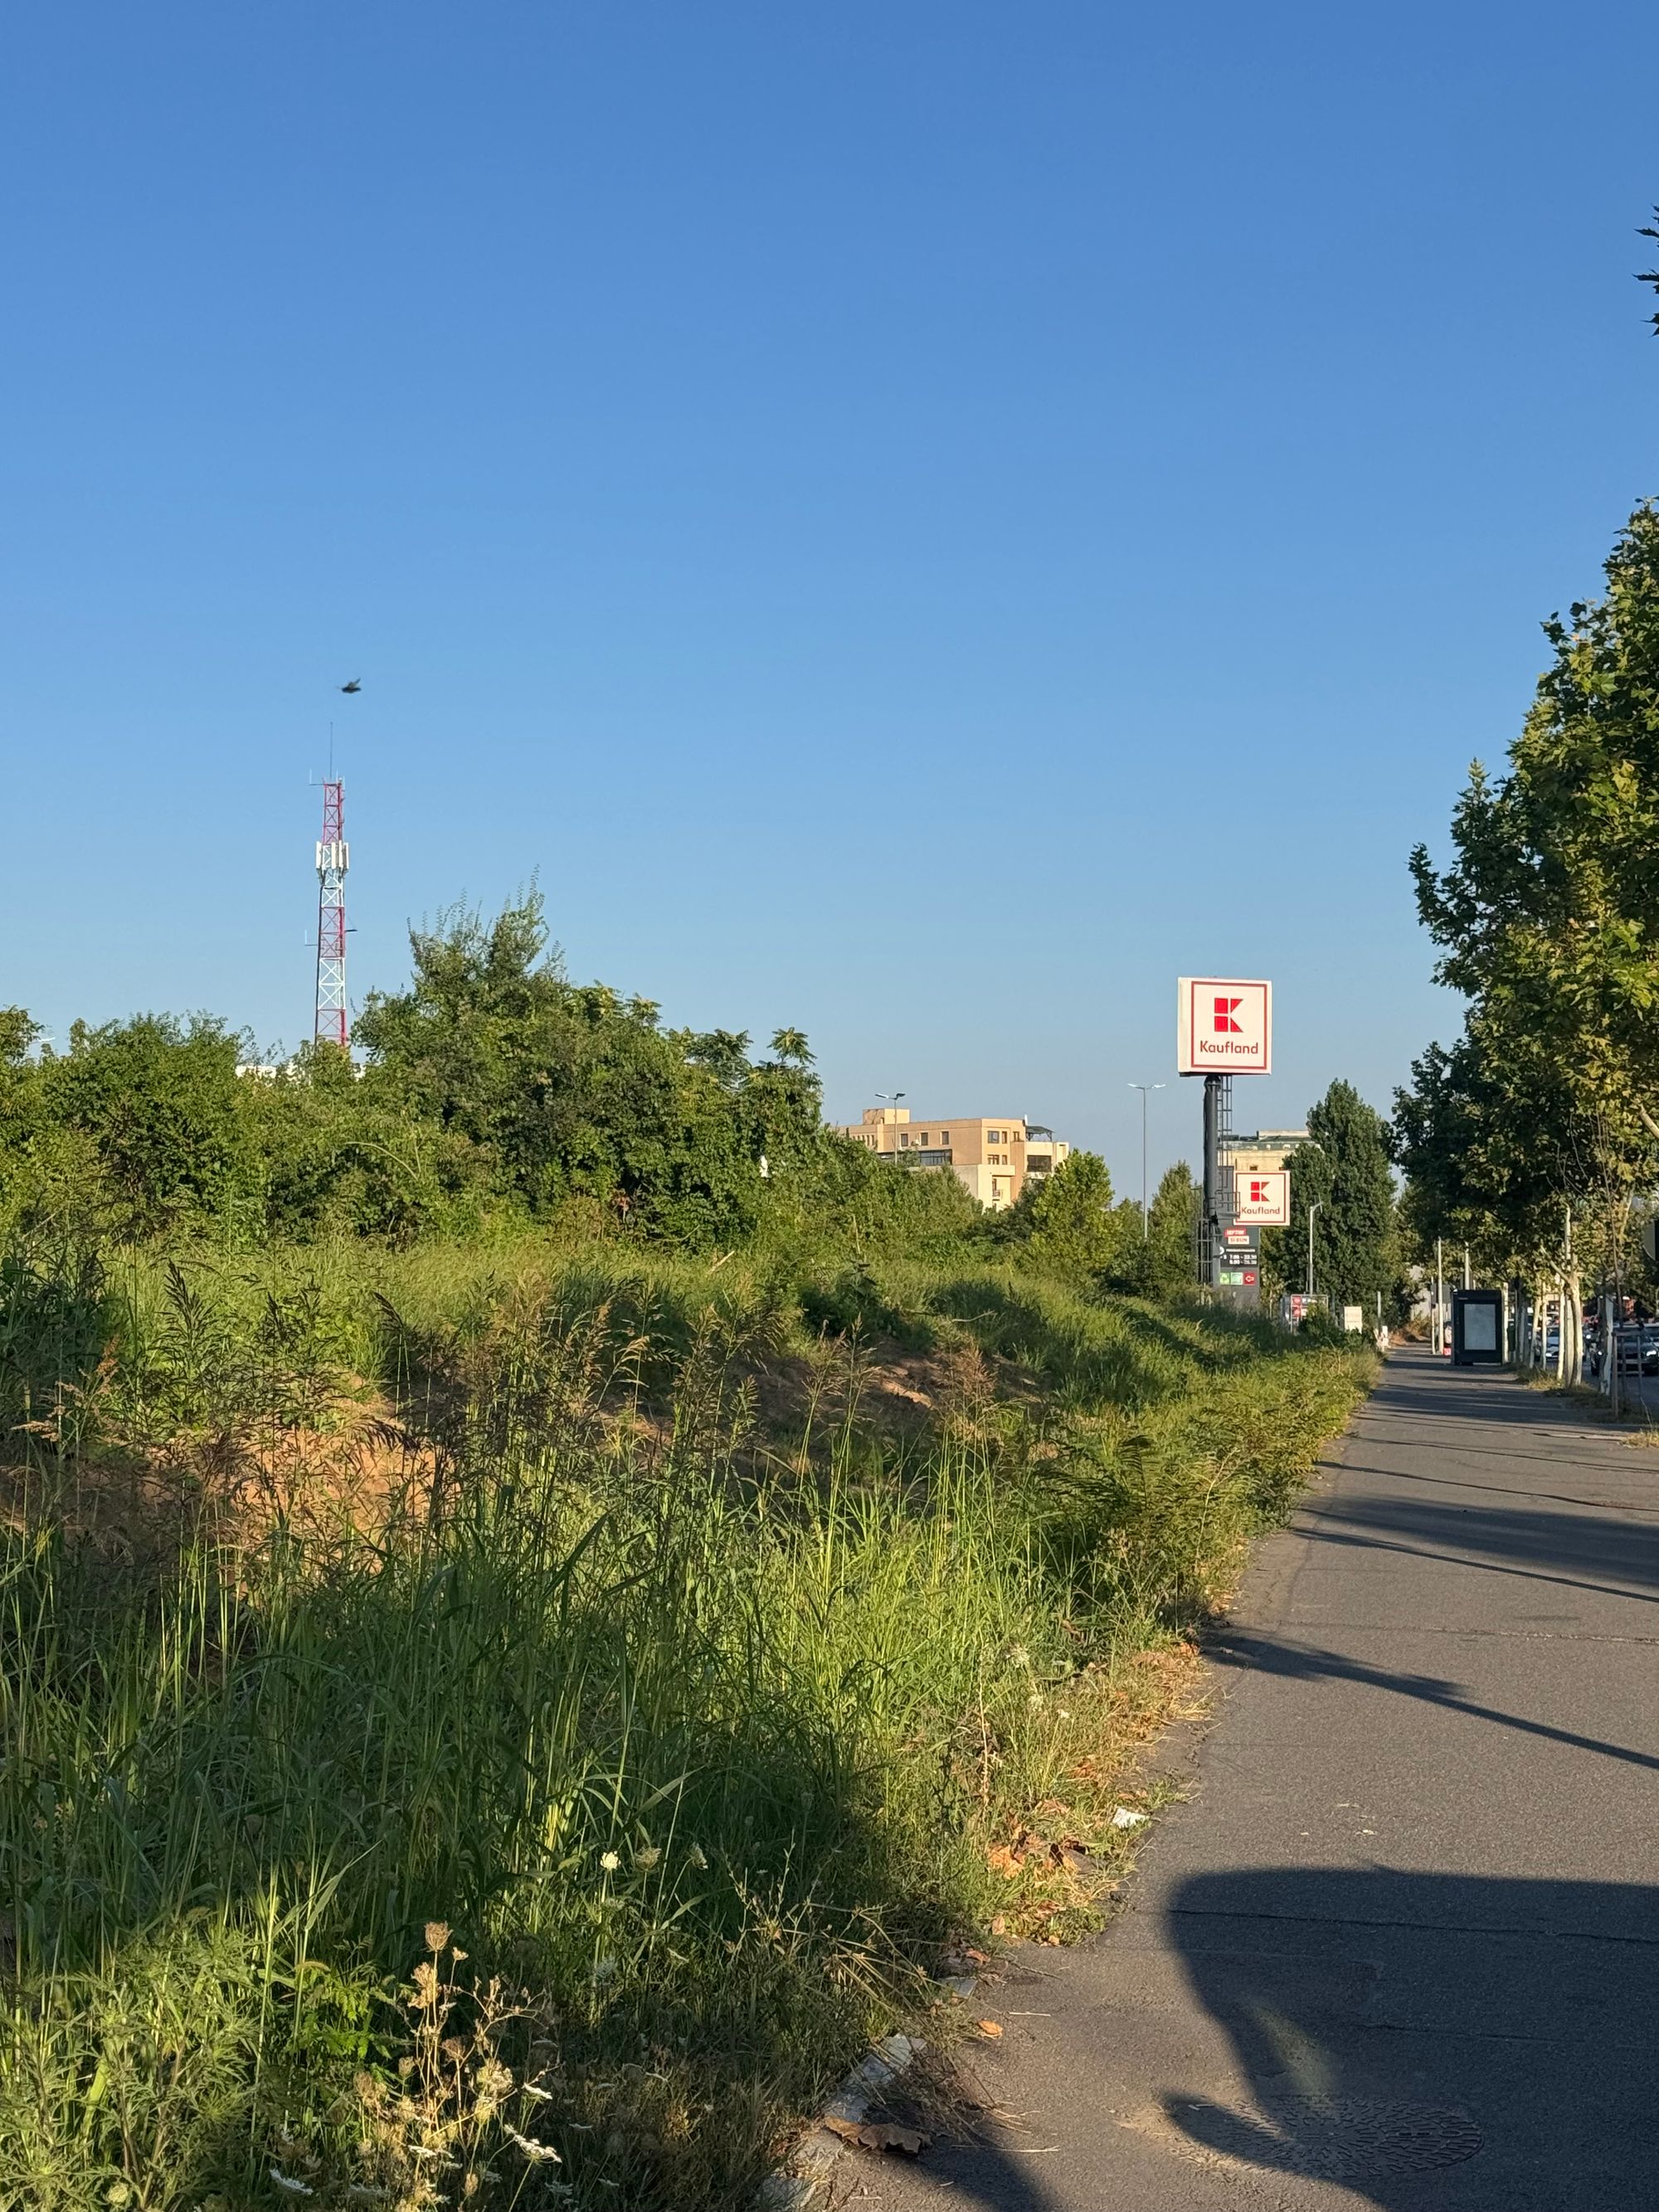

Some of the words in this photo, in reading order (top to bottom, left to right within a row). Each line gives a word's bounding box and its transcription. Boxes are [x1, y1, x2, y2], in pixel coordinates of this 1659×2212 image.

[1214, 998, 1243, 1033] K
[1200, 1040, 1258, 1054] Kaufland
[1251, 1182, 1270, 1202] K
